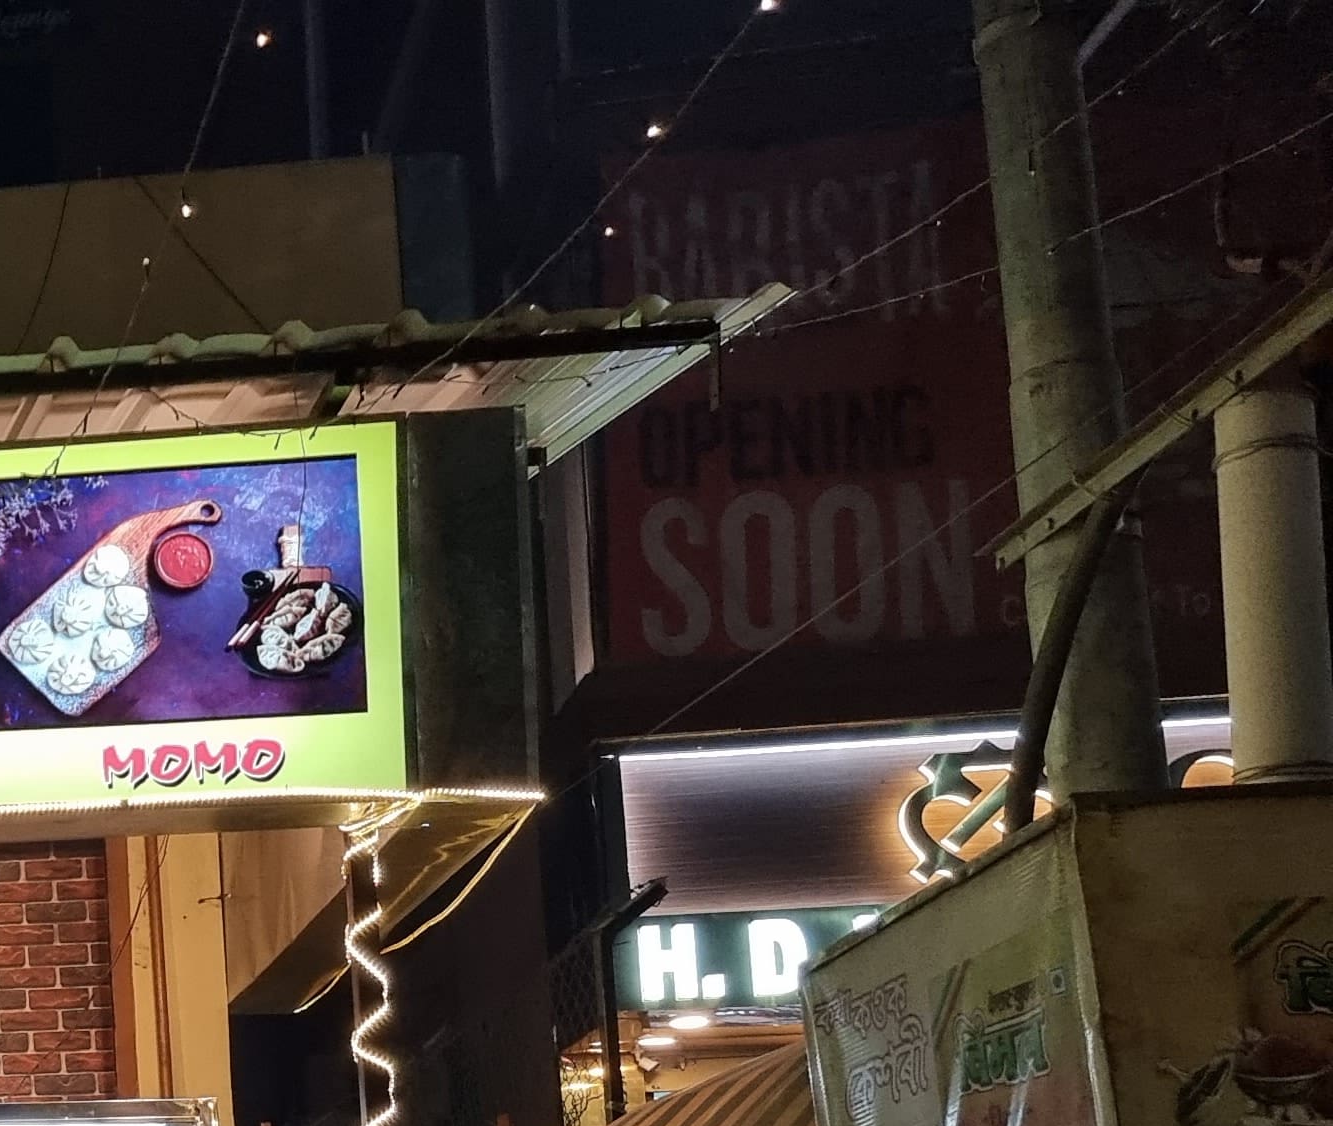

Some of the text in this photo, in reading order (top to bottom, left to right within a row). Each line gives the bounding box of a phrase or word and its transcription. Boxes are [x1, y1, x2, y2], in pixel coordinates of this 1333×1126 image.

[640, 384, 933, 490] OPENING
[639, 479, 981, 657] SOON
[102, 738, 284, 789] MOMO
[637, 923, 726, 1003] H.
